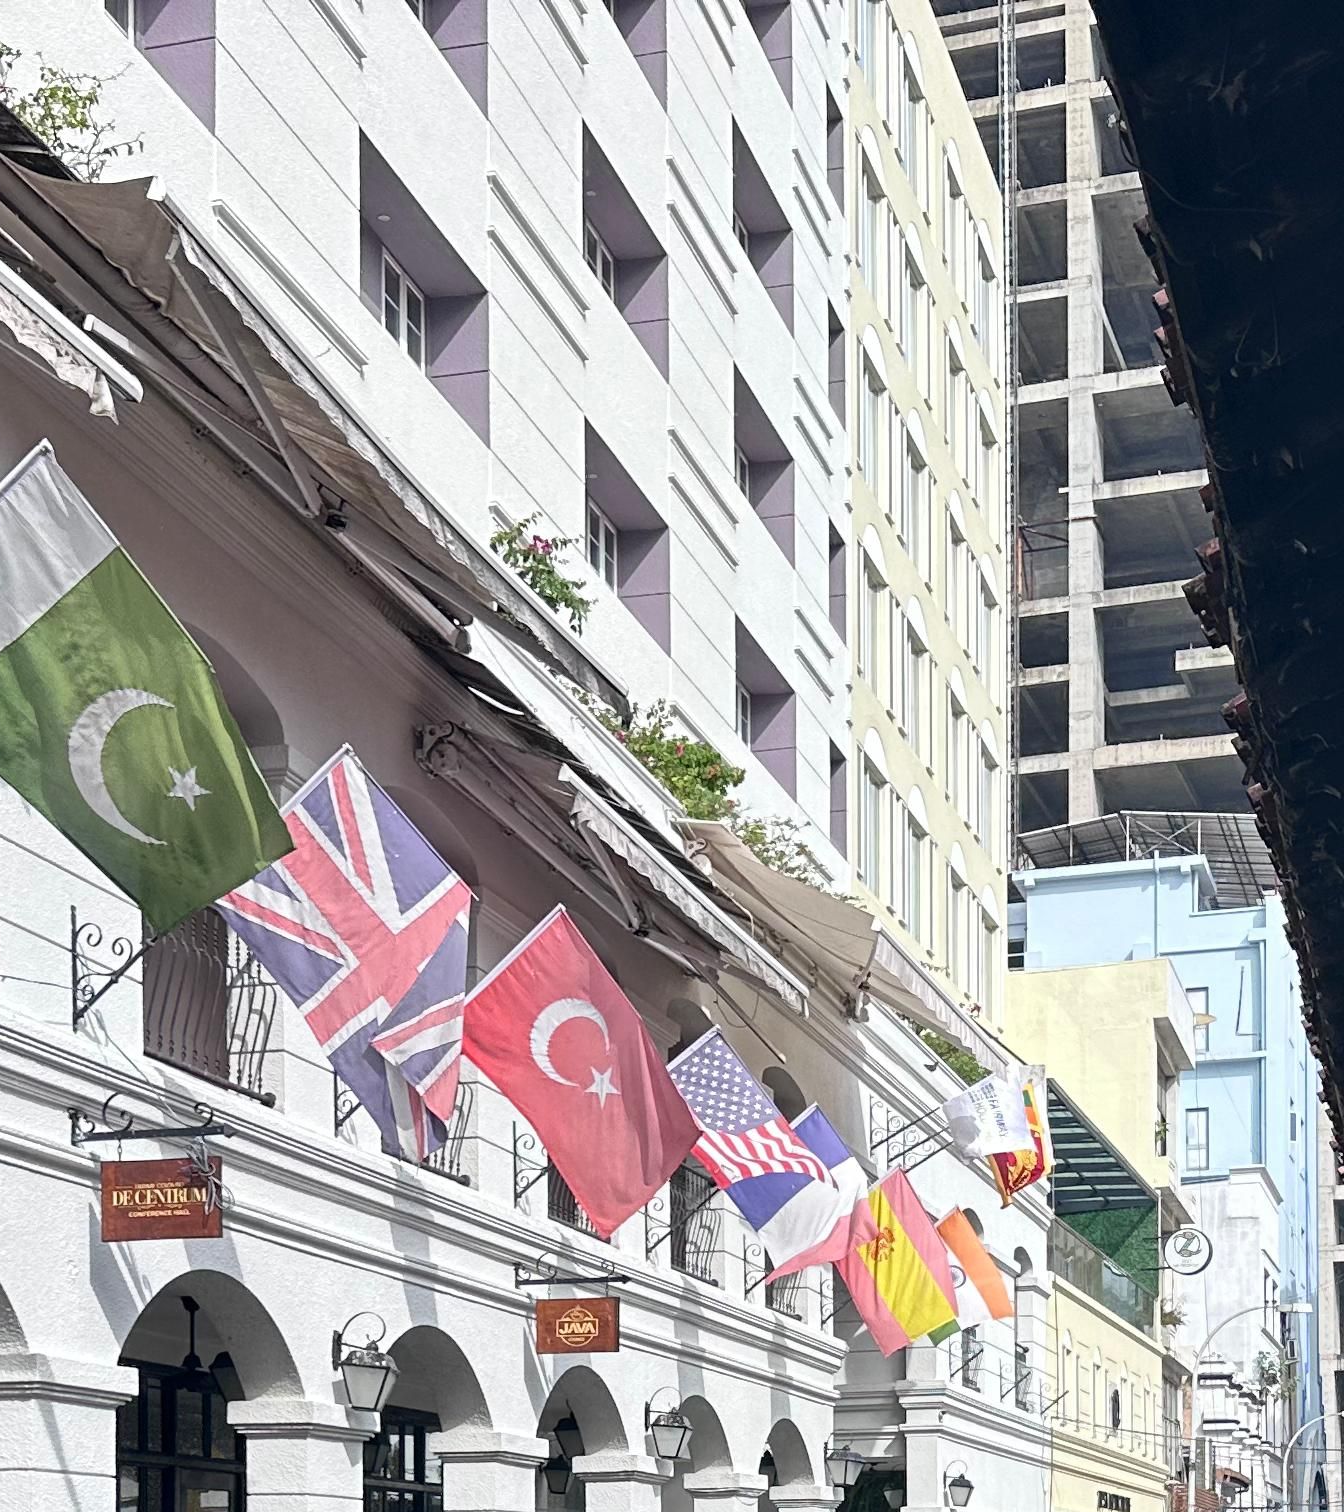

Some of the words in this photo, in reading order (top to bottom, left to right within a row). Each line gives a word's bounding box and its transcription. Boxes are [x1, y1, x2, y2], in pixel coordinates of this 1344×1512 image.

[112, 1189, 133, 1206] DE
[134, 1186, 207, 1205] CENTRUM
[558, 1322, 596, 1335] JAVA
